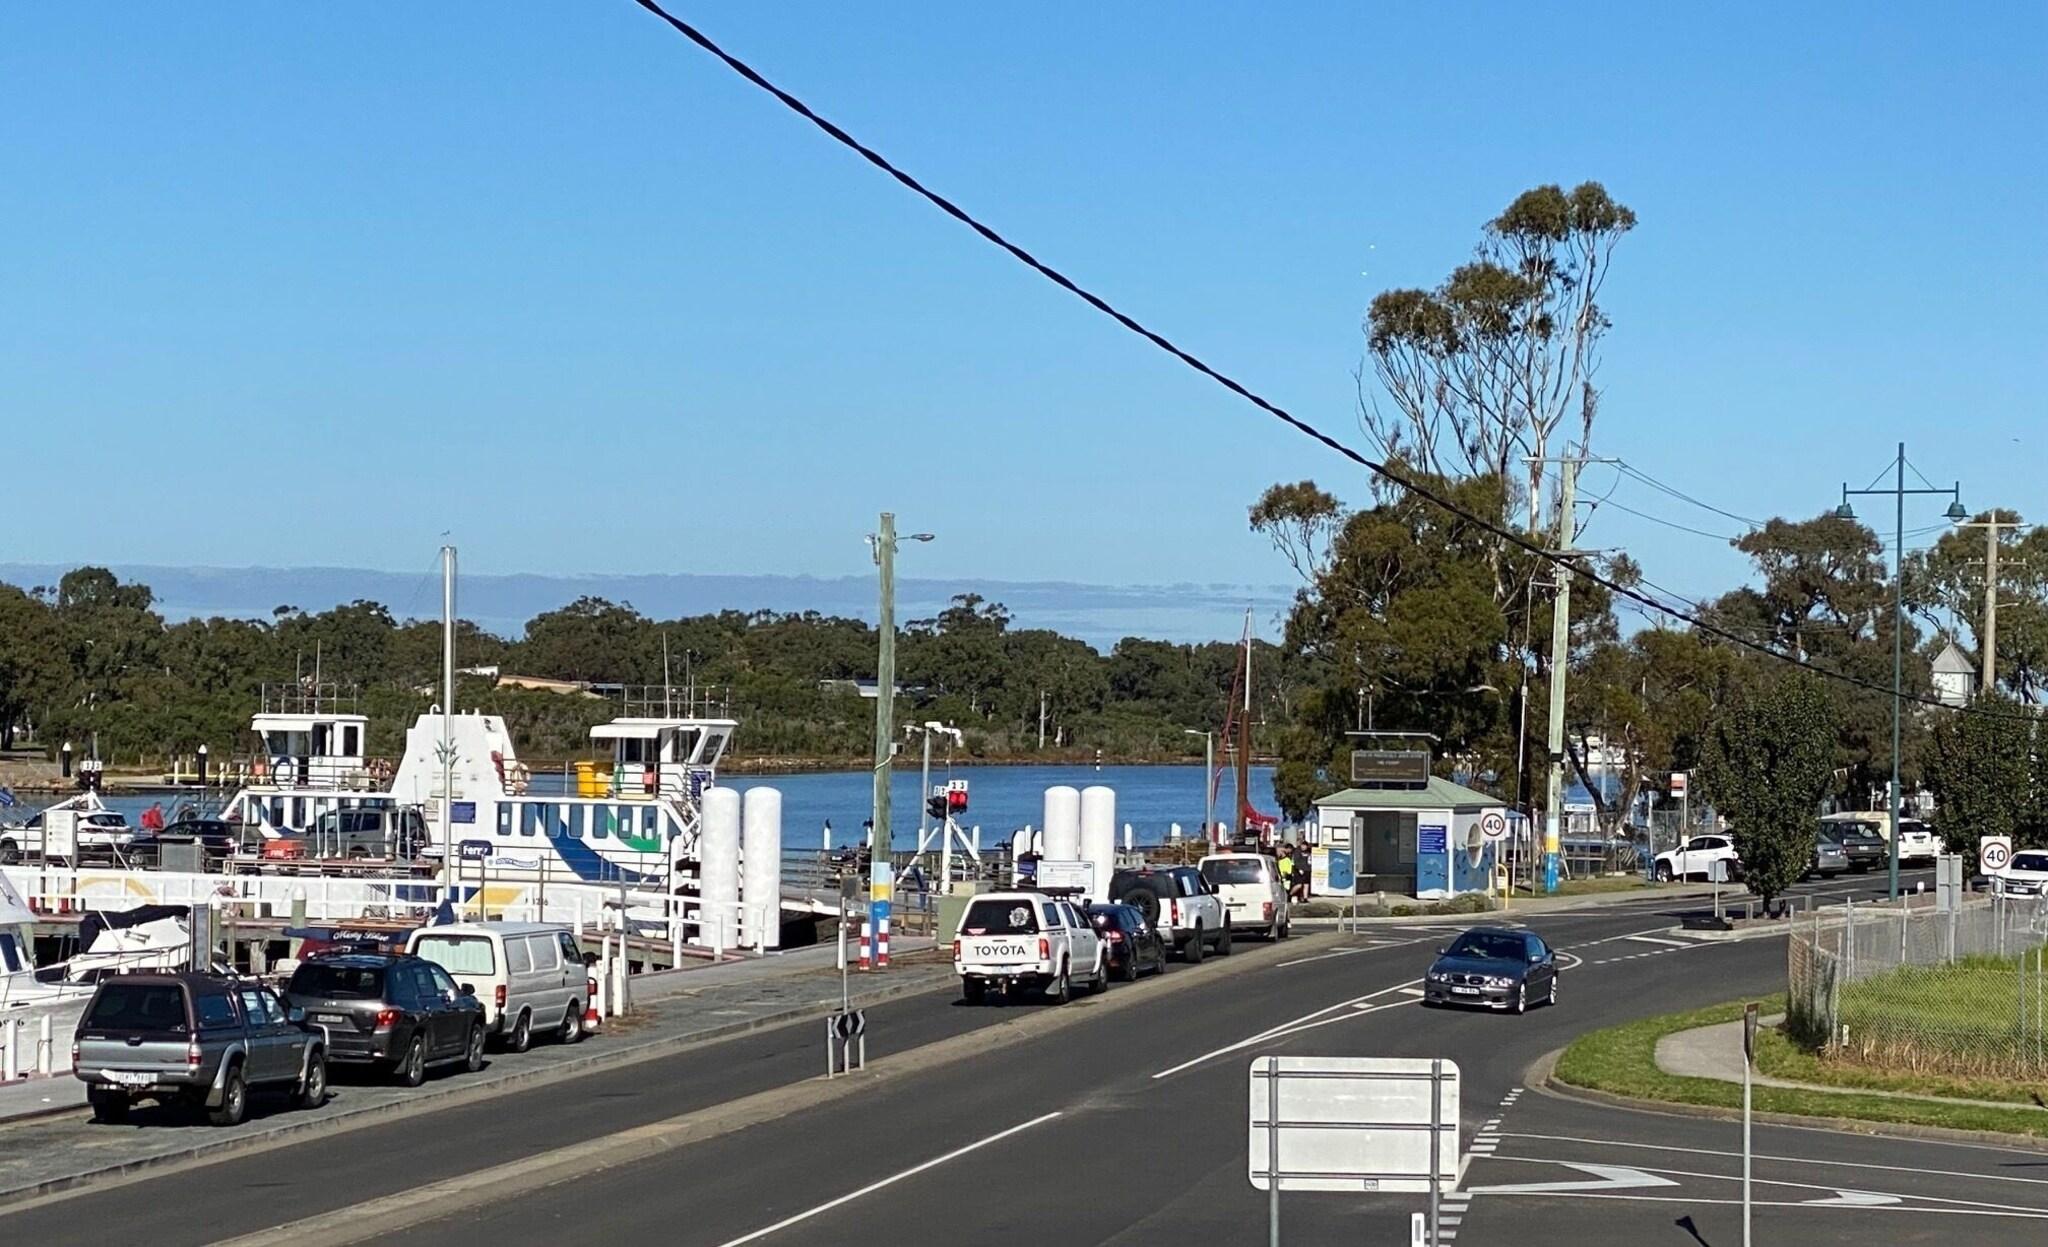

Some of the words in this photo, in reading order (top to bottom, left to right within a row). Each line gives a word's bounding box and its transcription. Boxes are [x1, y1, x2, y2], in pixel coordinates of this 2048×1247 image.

[1485, 820, 1501, 831] 40
[463, 845, 489, 856] Ferry
[1986, 850, 2006, 862] 40
[974, 945, 1026, 956] TOYOTA
